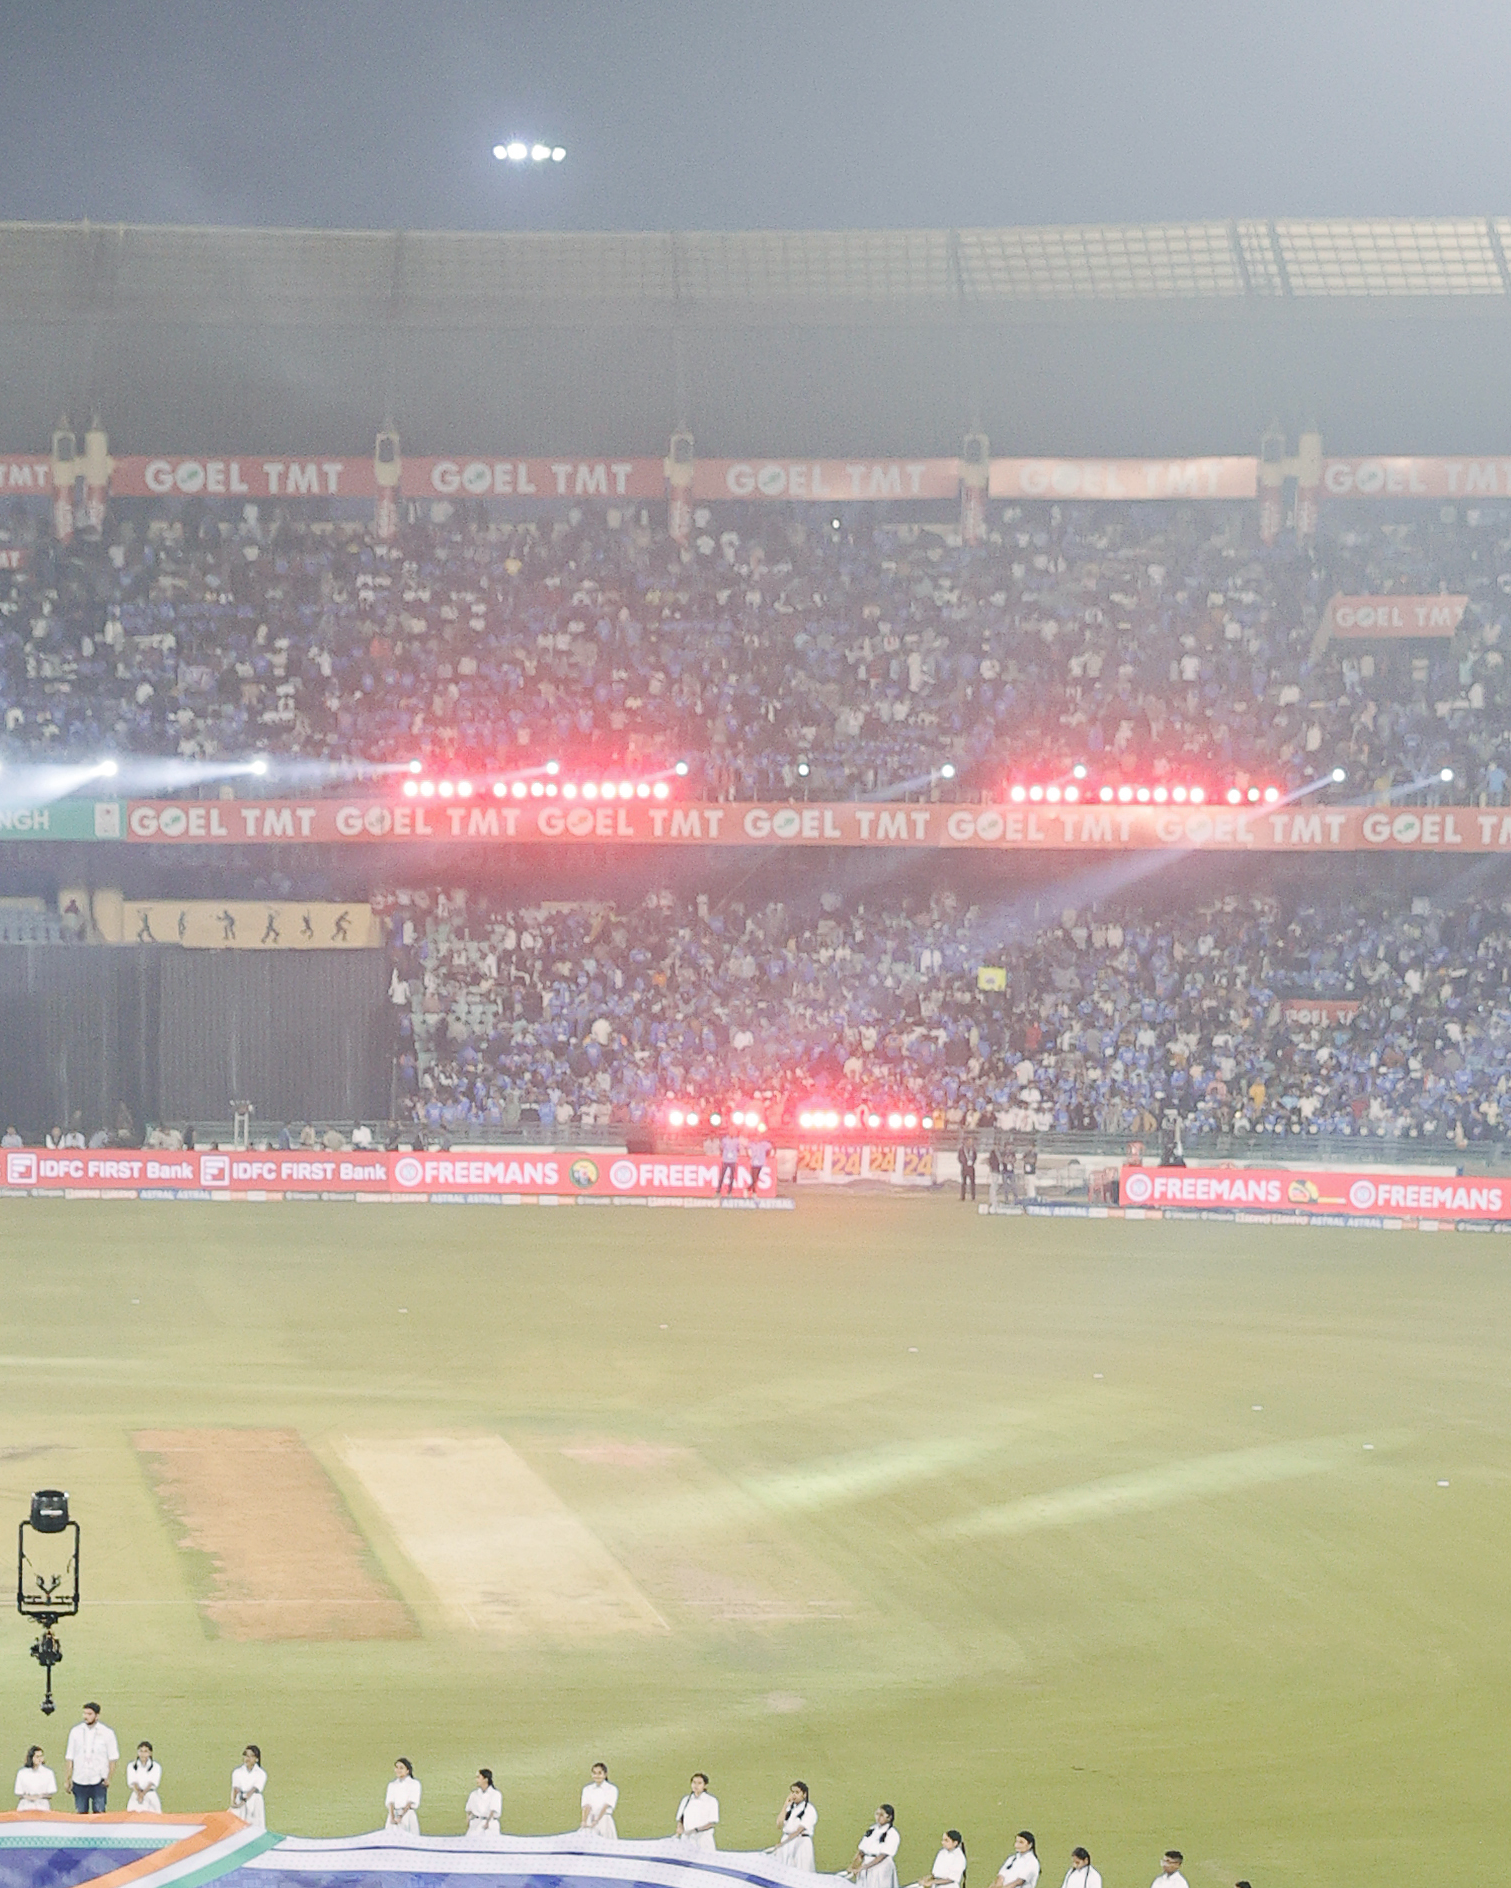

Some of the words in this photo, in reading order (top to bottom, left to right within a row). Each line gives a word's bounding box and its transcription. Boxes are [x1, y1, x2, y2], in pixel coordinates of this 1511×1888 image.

[145, 461, 249, 493] GOEL
[262, 462, 344, 496] TMT
[431, 462, 536, 496] GOEL
[551, 463, 633, 496] TMT
[726, 463, 830, 496] GOEL
[844, 464, 927, 495] TMT
[1323, 463, 1429, 494] GOEL
[1335, 604, 1405, 629] GOEL
[129, 806, 229, 838] GOEL
[240, 806, 317, 838] TMT
[335, 806, 434, 838] GOEL
[446, 807, 522, 837] TMT
[537, 807, 635, 838] GOEL
[648, 807, 724, 838] TMT
[743, 808, 841, 839] GOEL
[853, 810, 931, 841] TMT
[947, 810, 1044, 842] GOEL
[1062, 811, 1135, 842] TMT
[1155, 812, 1256, 842] GOEL
[1270, 814, 1347, 844] TMT
[1361, 814, 1462, 844] GOEL
[39, 1160, 85, 1178] IDFC
[88, 1160, 141, 1178] FIRST
[146, 1160, 194, 1178] Bank
[231, 1161, 277, 1180] IDFC
[280, 1161, 335, 1180] FIRST
[339, 1161, 387, 1180] Bank
[424, 1160, 560, 1187] FREEMANS
[1153, 1177, 1281, 1203] FREEMANS
[1377, 1183, 1503, 1211] FREEMANS
